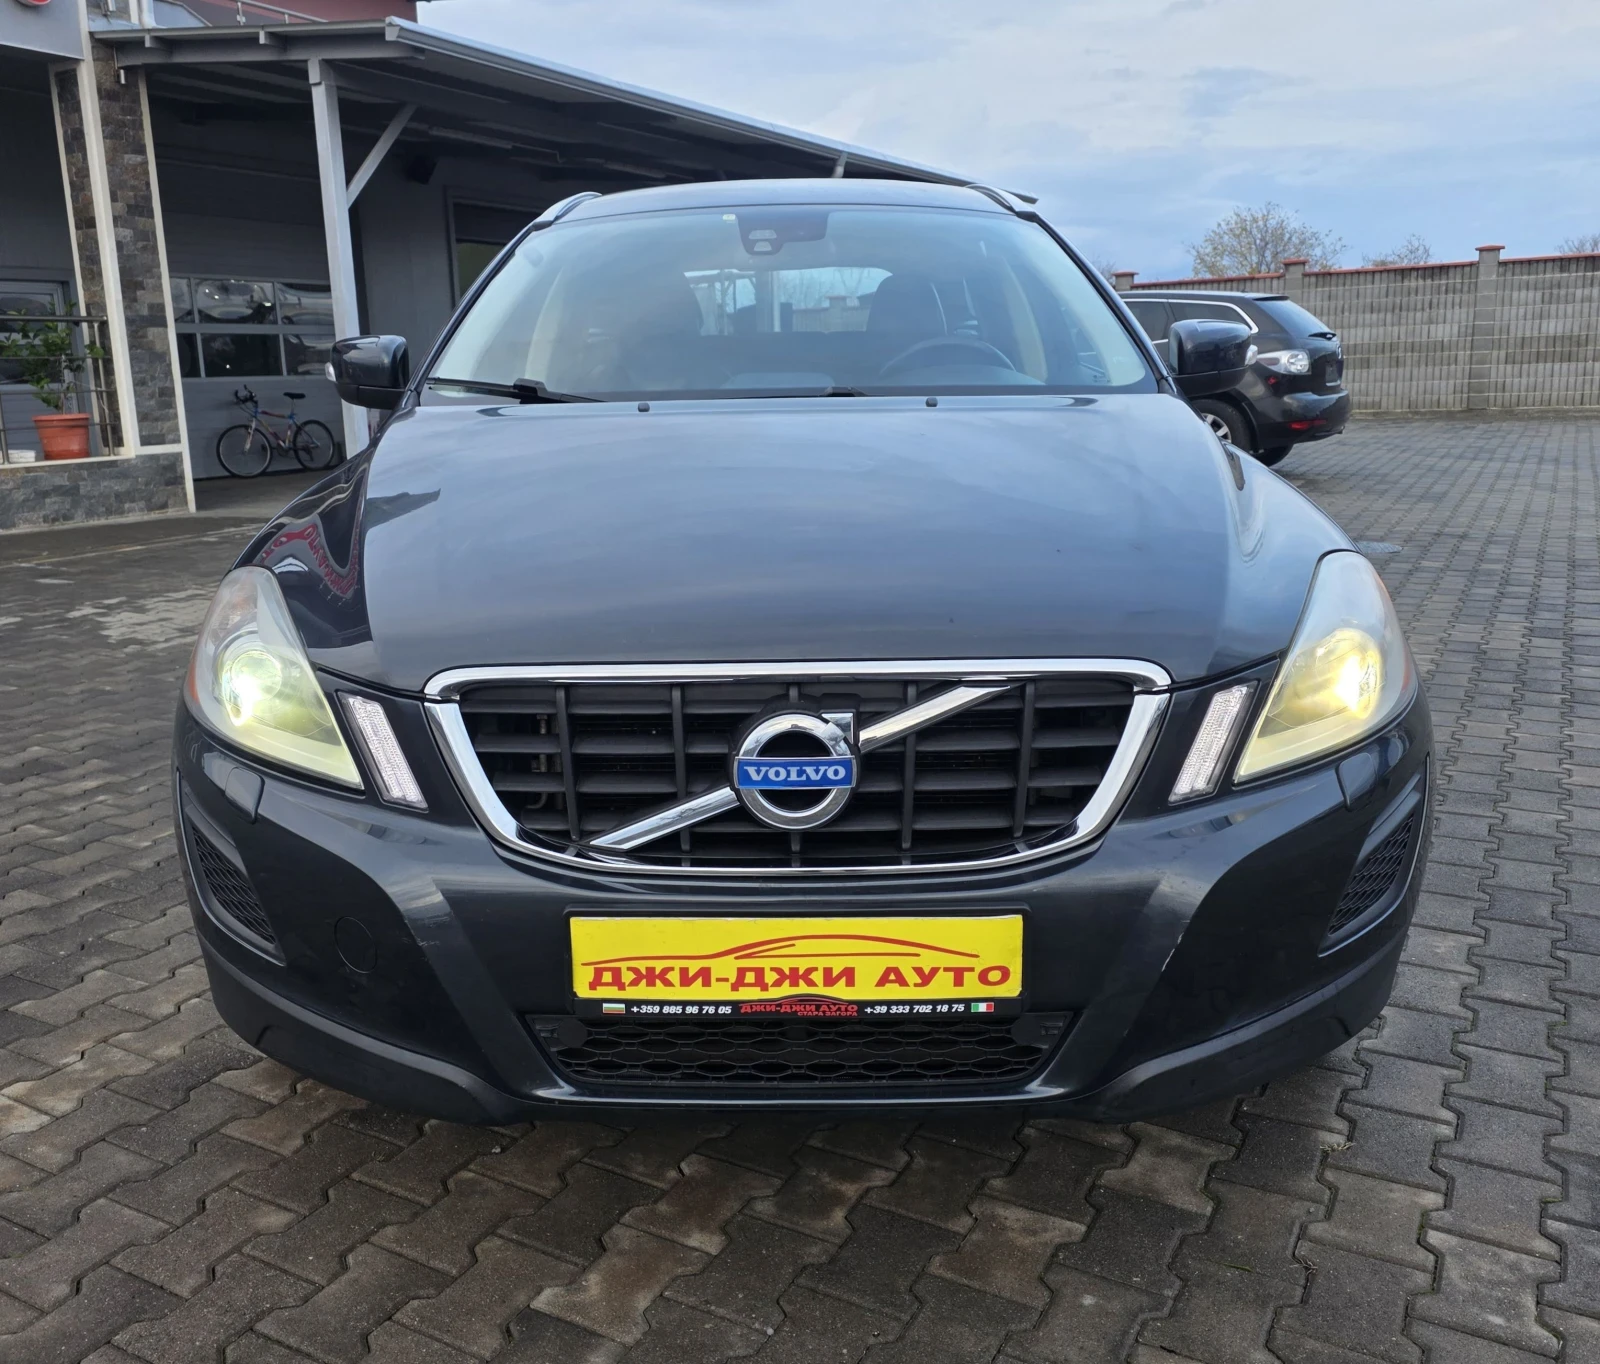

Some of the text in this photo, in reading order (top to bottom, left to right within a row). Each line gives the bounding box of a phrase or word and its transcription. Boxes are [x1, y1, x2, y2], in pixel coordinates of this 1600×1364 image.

[744, 765, 846, 781] VOLVO
[588, 965, 1011, 992] ДЖИ-ДЖИ АУТО
[631, 1005, 732, 1014] +359 885 96 76 05
[740, 1004, 858, 1013] ДЖИ-ДЖИ АУТО
[864, 1003, 965, 1014] +39 333 702 18 75
